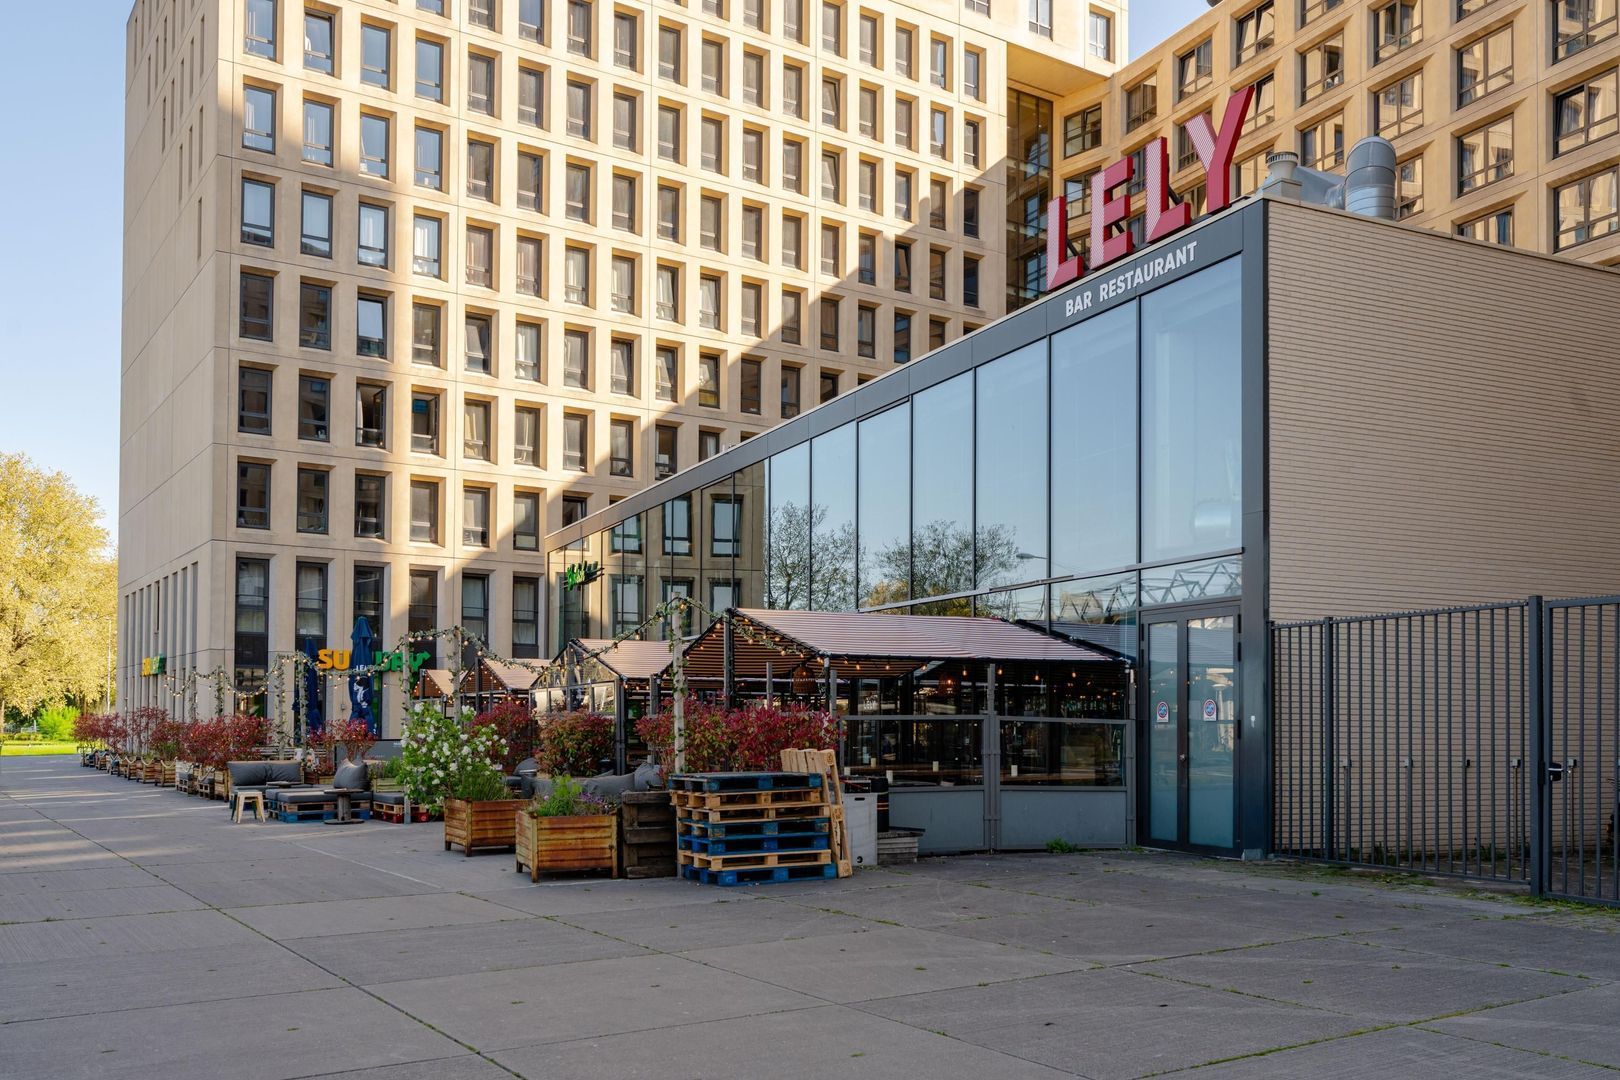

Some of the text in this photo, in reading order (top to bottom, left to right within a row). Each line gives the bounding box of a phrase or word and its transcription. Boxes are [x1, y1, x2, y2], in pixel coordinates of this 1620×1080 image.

[1046, 85, 1255, 292] LELY
[1065, 241, 1197, 317] BAR RESTAURANT
[317, 648, 432, 673] SUWAY
